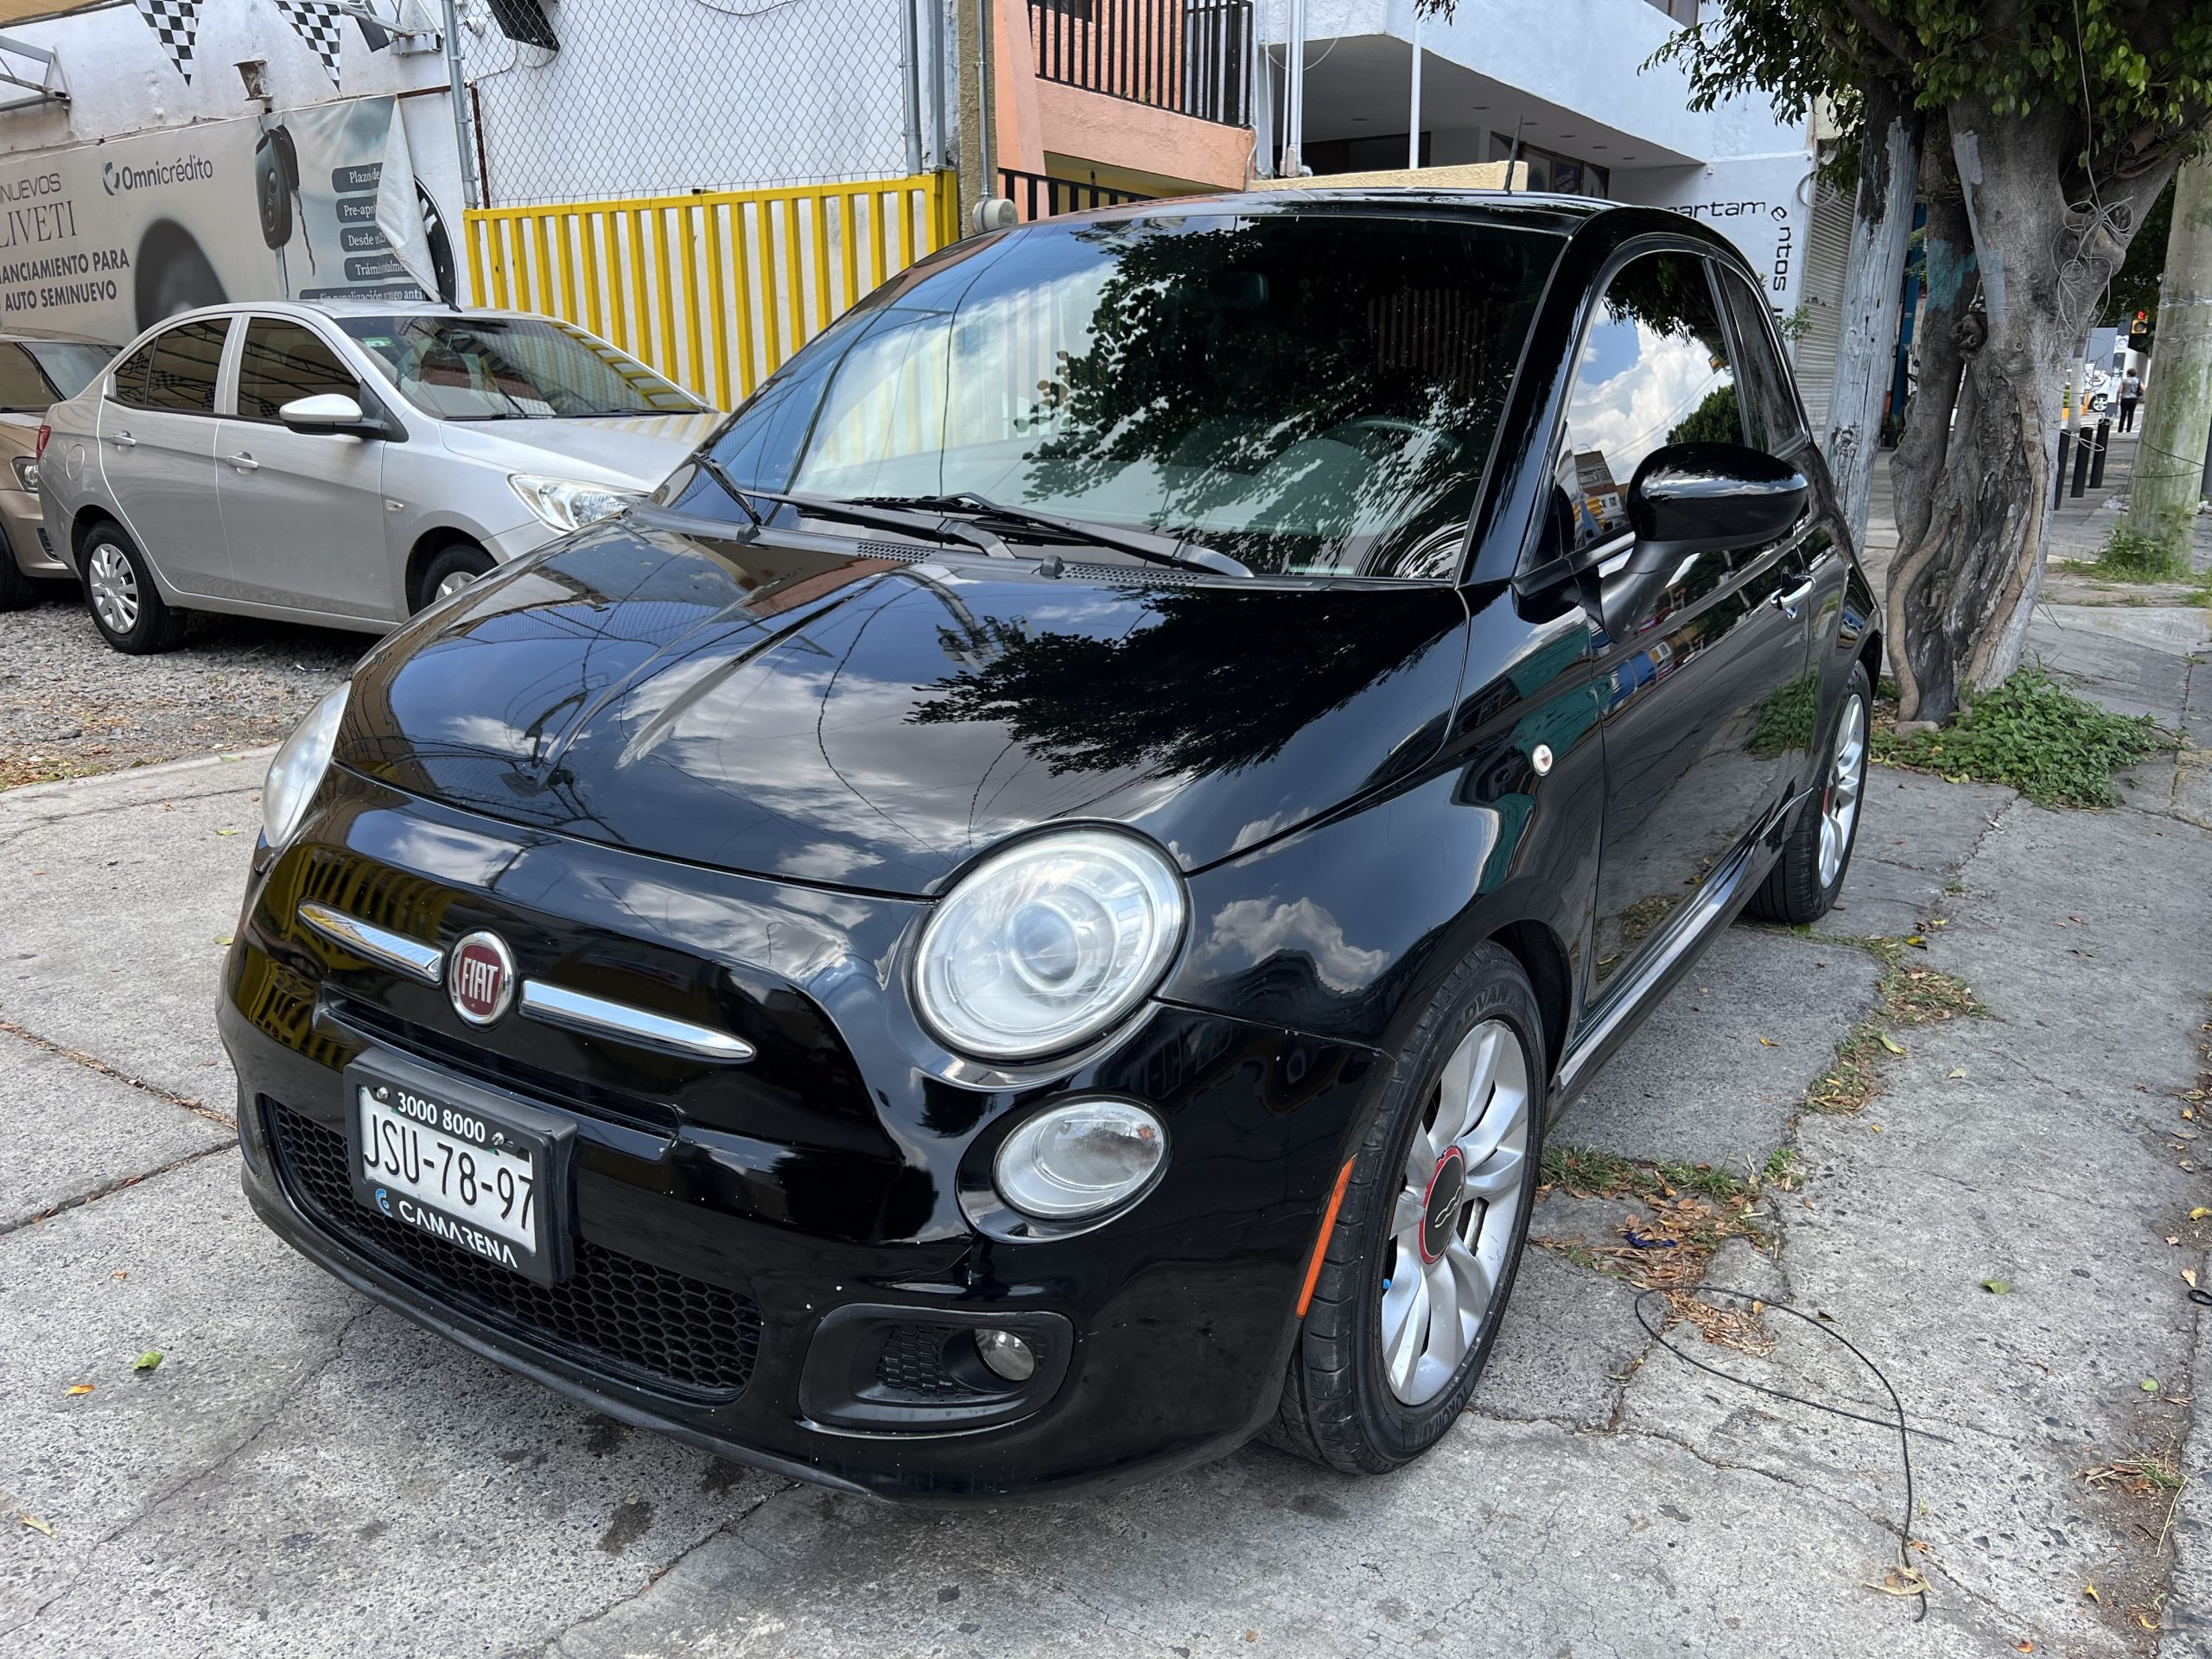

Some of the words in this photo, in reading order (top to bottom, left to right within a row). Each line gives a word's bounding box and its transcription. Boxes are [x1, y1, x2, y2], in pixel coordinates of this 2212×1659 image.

[122, 155, 213, 190] Omnicrédito
[348, 233, 374, 246] Desde
[0, 253, 88, 284] ANCIAMIENTO
[92, 248, 130, 271] PARA
[5, 289, 37, 312] AUTO
[41, 280, 117, 308] SEMINUEVO
[461, 957, 499, 1004] FIAT
[397, 1092, 437, 1125] 3000
[442, 1109, 486, 1143] 8000
[364, 1114, 533, 1230] JSU-78-97
[398, 1200, 518, 1268] CAMARENA
